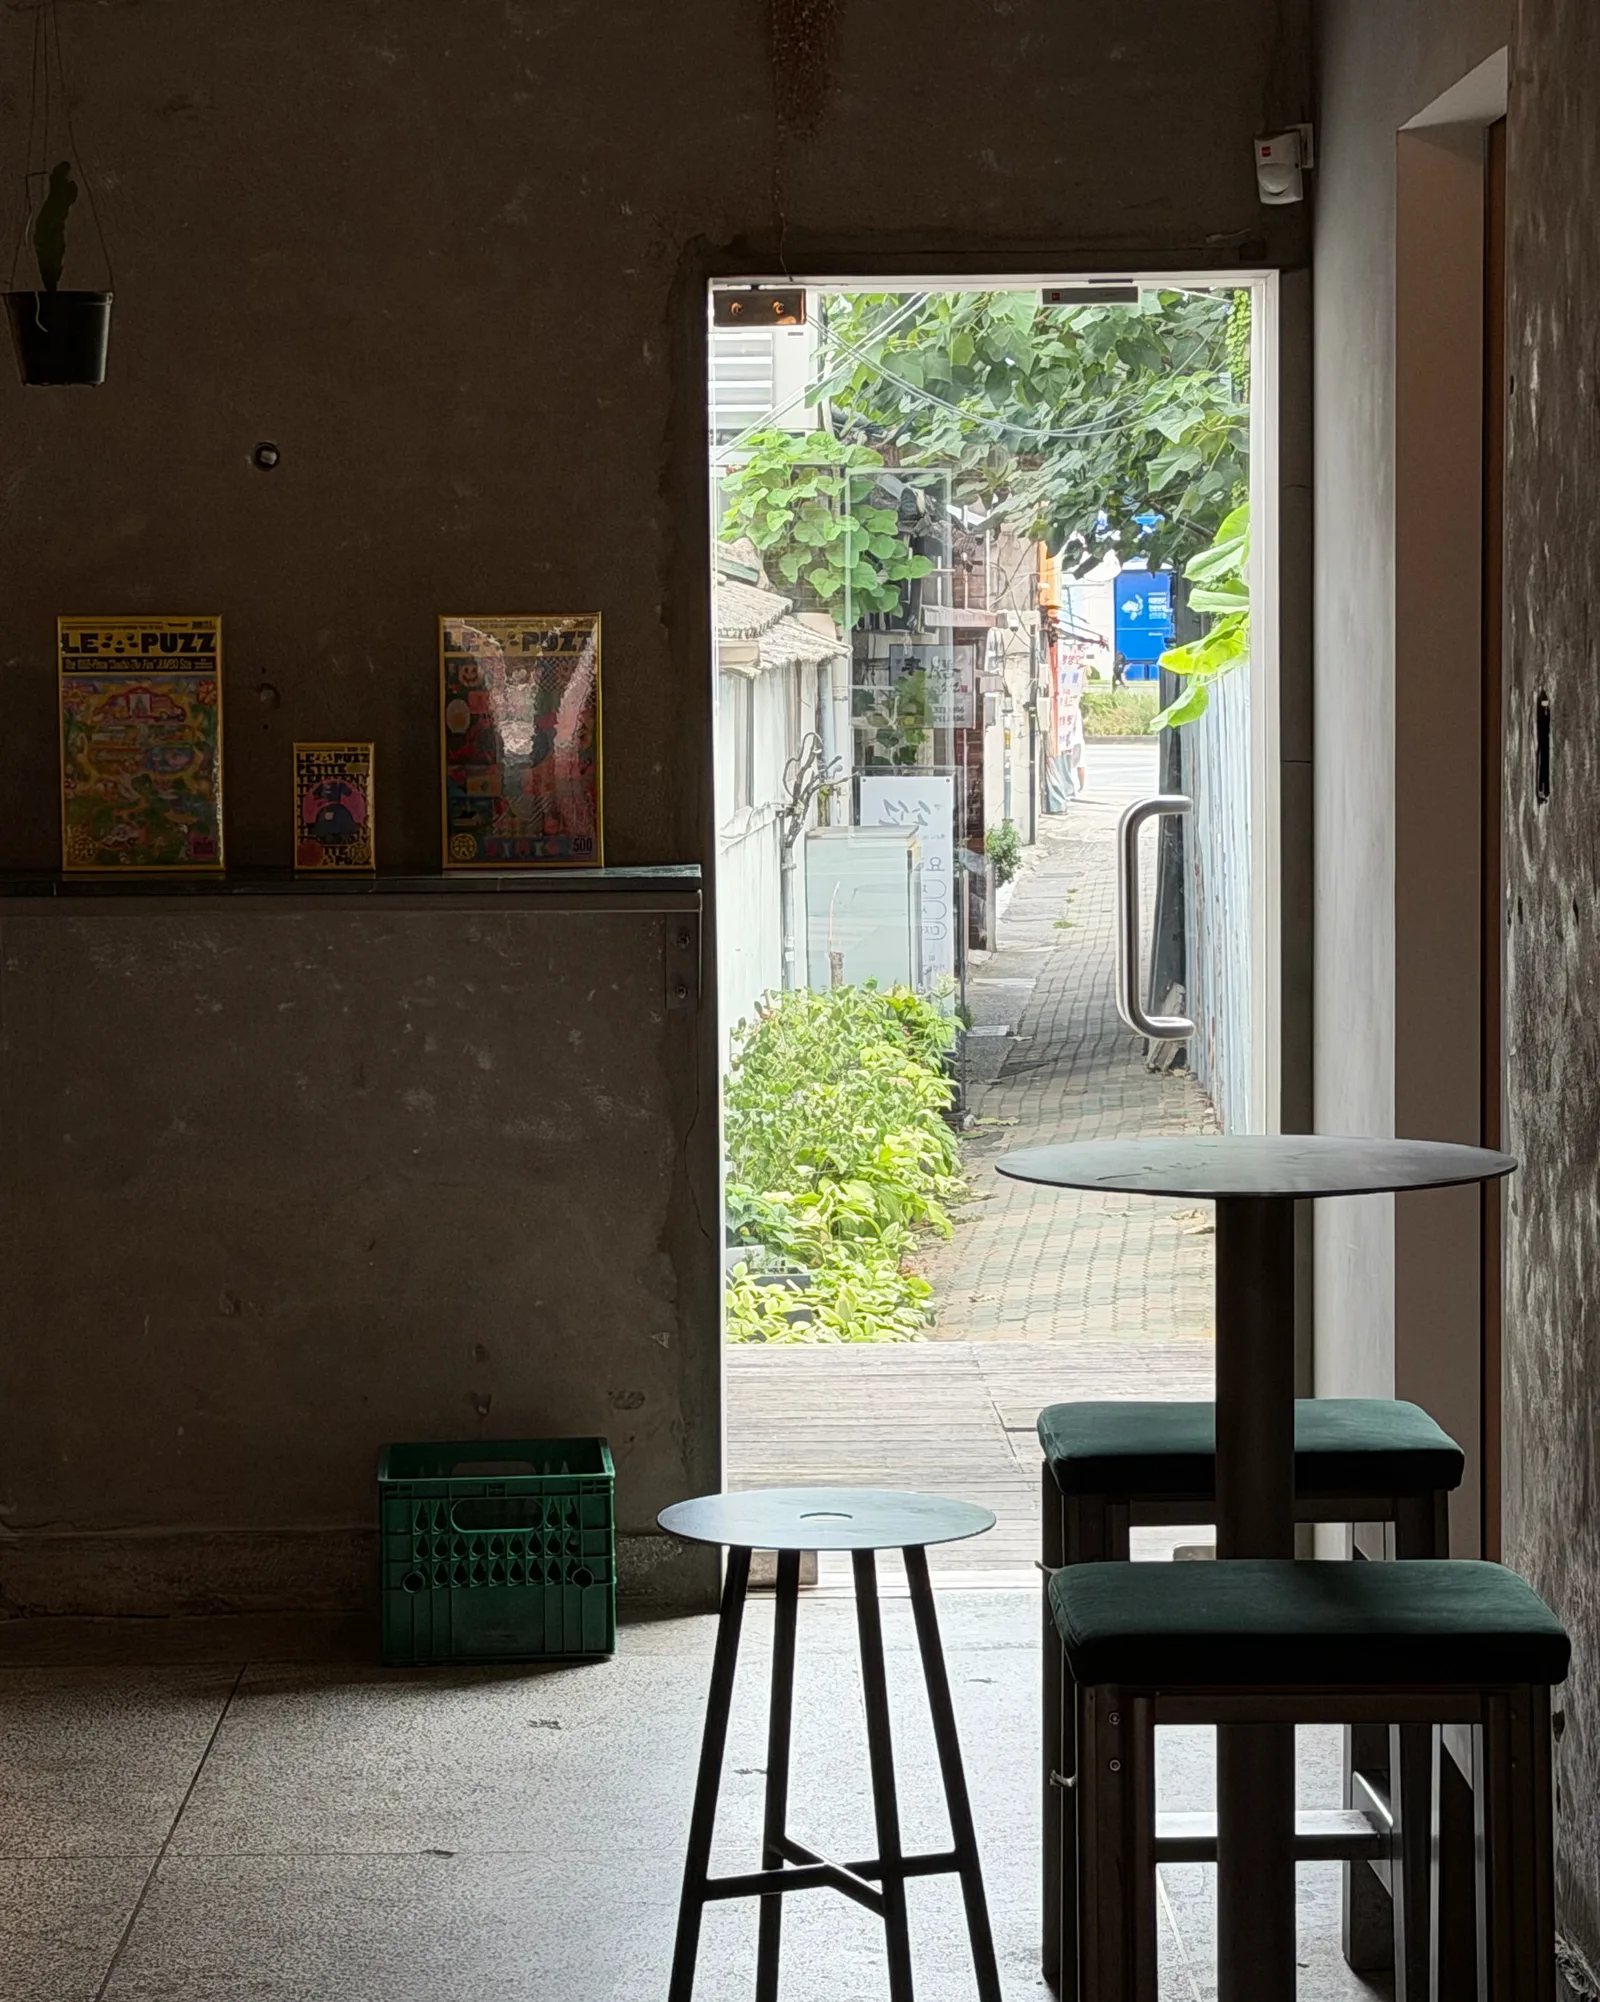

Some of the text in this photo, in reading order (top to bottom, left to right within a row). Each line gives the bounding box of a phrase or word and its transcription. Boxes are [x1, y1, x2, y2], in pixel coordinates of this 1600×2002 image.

[62, 632, 216, 653] LE PUZZ
[443, 631, 480, 652] LE
[297, 753, 314, 763] LE
[572, 837, 593, 852] 500
